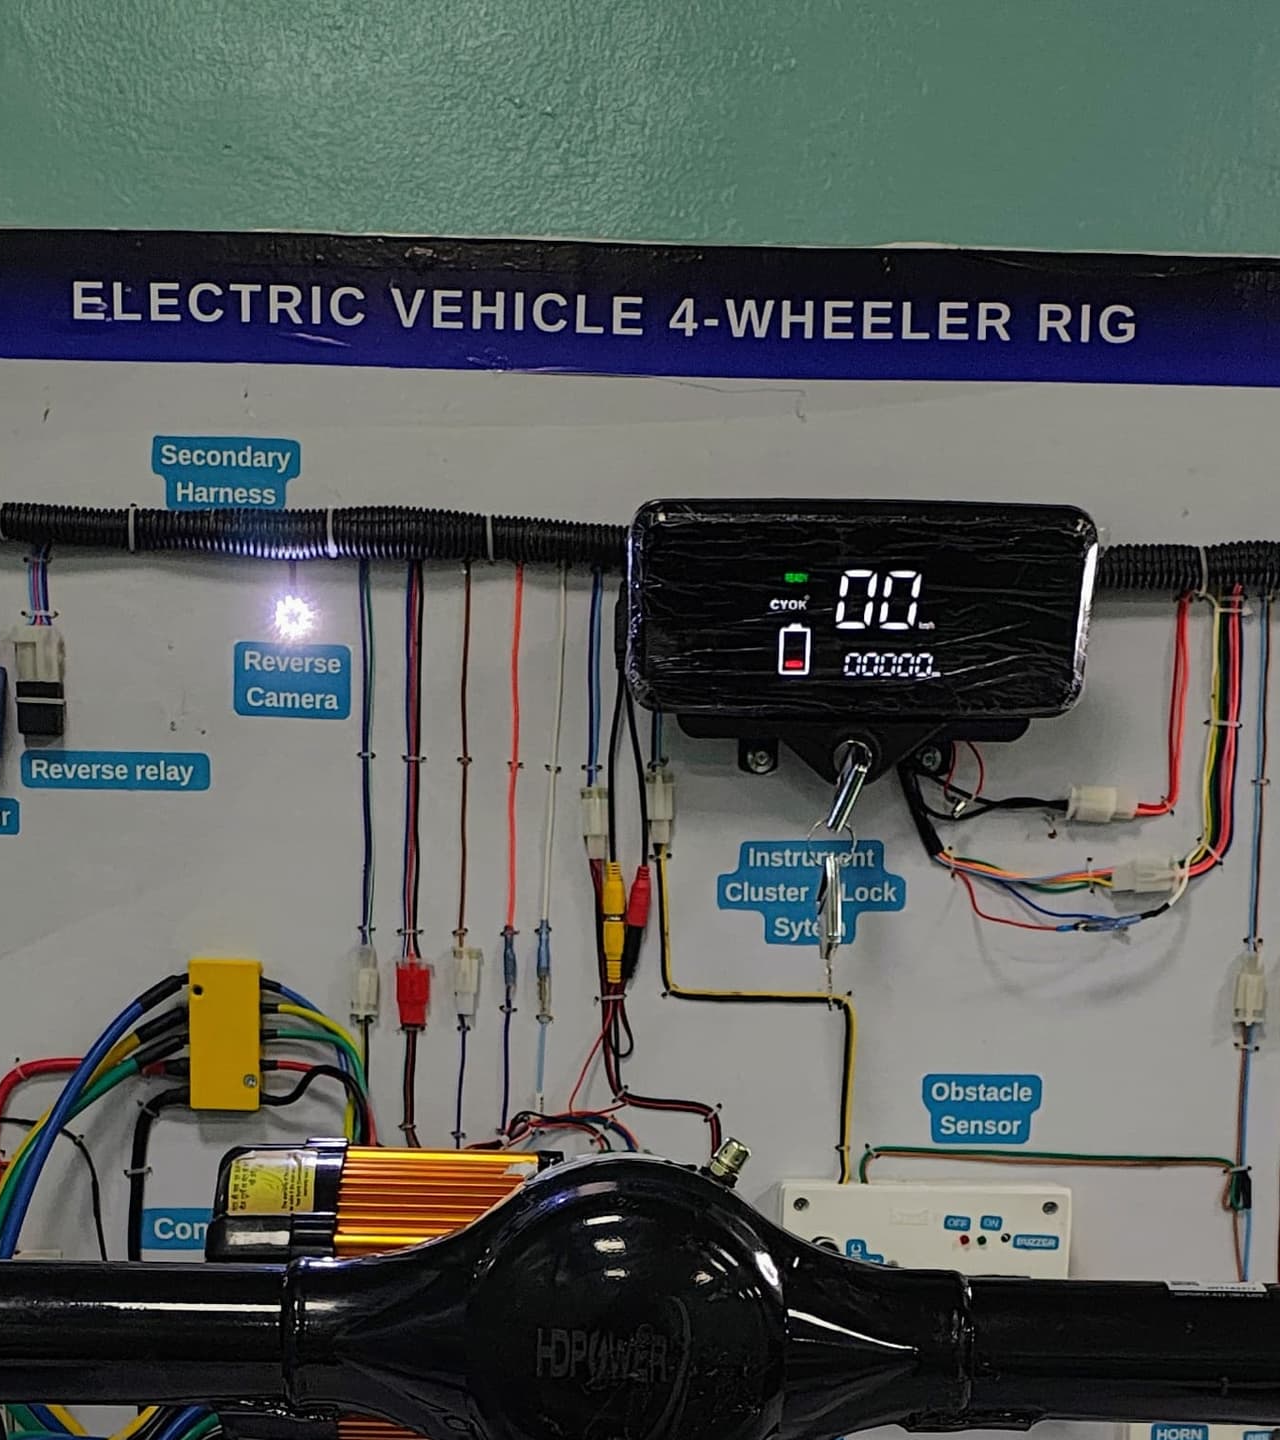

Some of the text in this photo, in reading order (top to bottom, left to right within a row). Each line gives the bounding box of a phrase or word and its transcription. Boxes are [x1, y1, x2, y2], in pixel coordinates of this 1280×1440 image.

[72, 280, 1137, 343] ELECTRIC VEHICLE 4-WHEELER RIG
[160, 443, 292, 474] Secondary
[176, 480, 277, 506] Harness
[769, 598, 807, 611] CYOK
[835, 569, 923, 631] 00
[243, 650, 342, 676] Reverse
[245, 685, 339, 712] Camera
[30, 757, 195, 787] Reverse relay
[724, 881, 898, 903] Cluster Lock
[930, 1080, 1033, 1104] Obstacle
[939, 1113, 1022, 1137] Sensor
